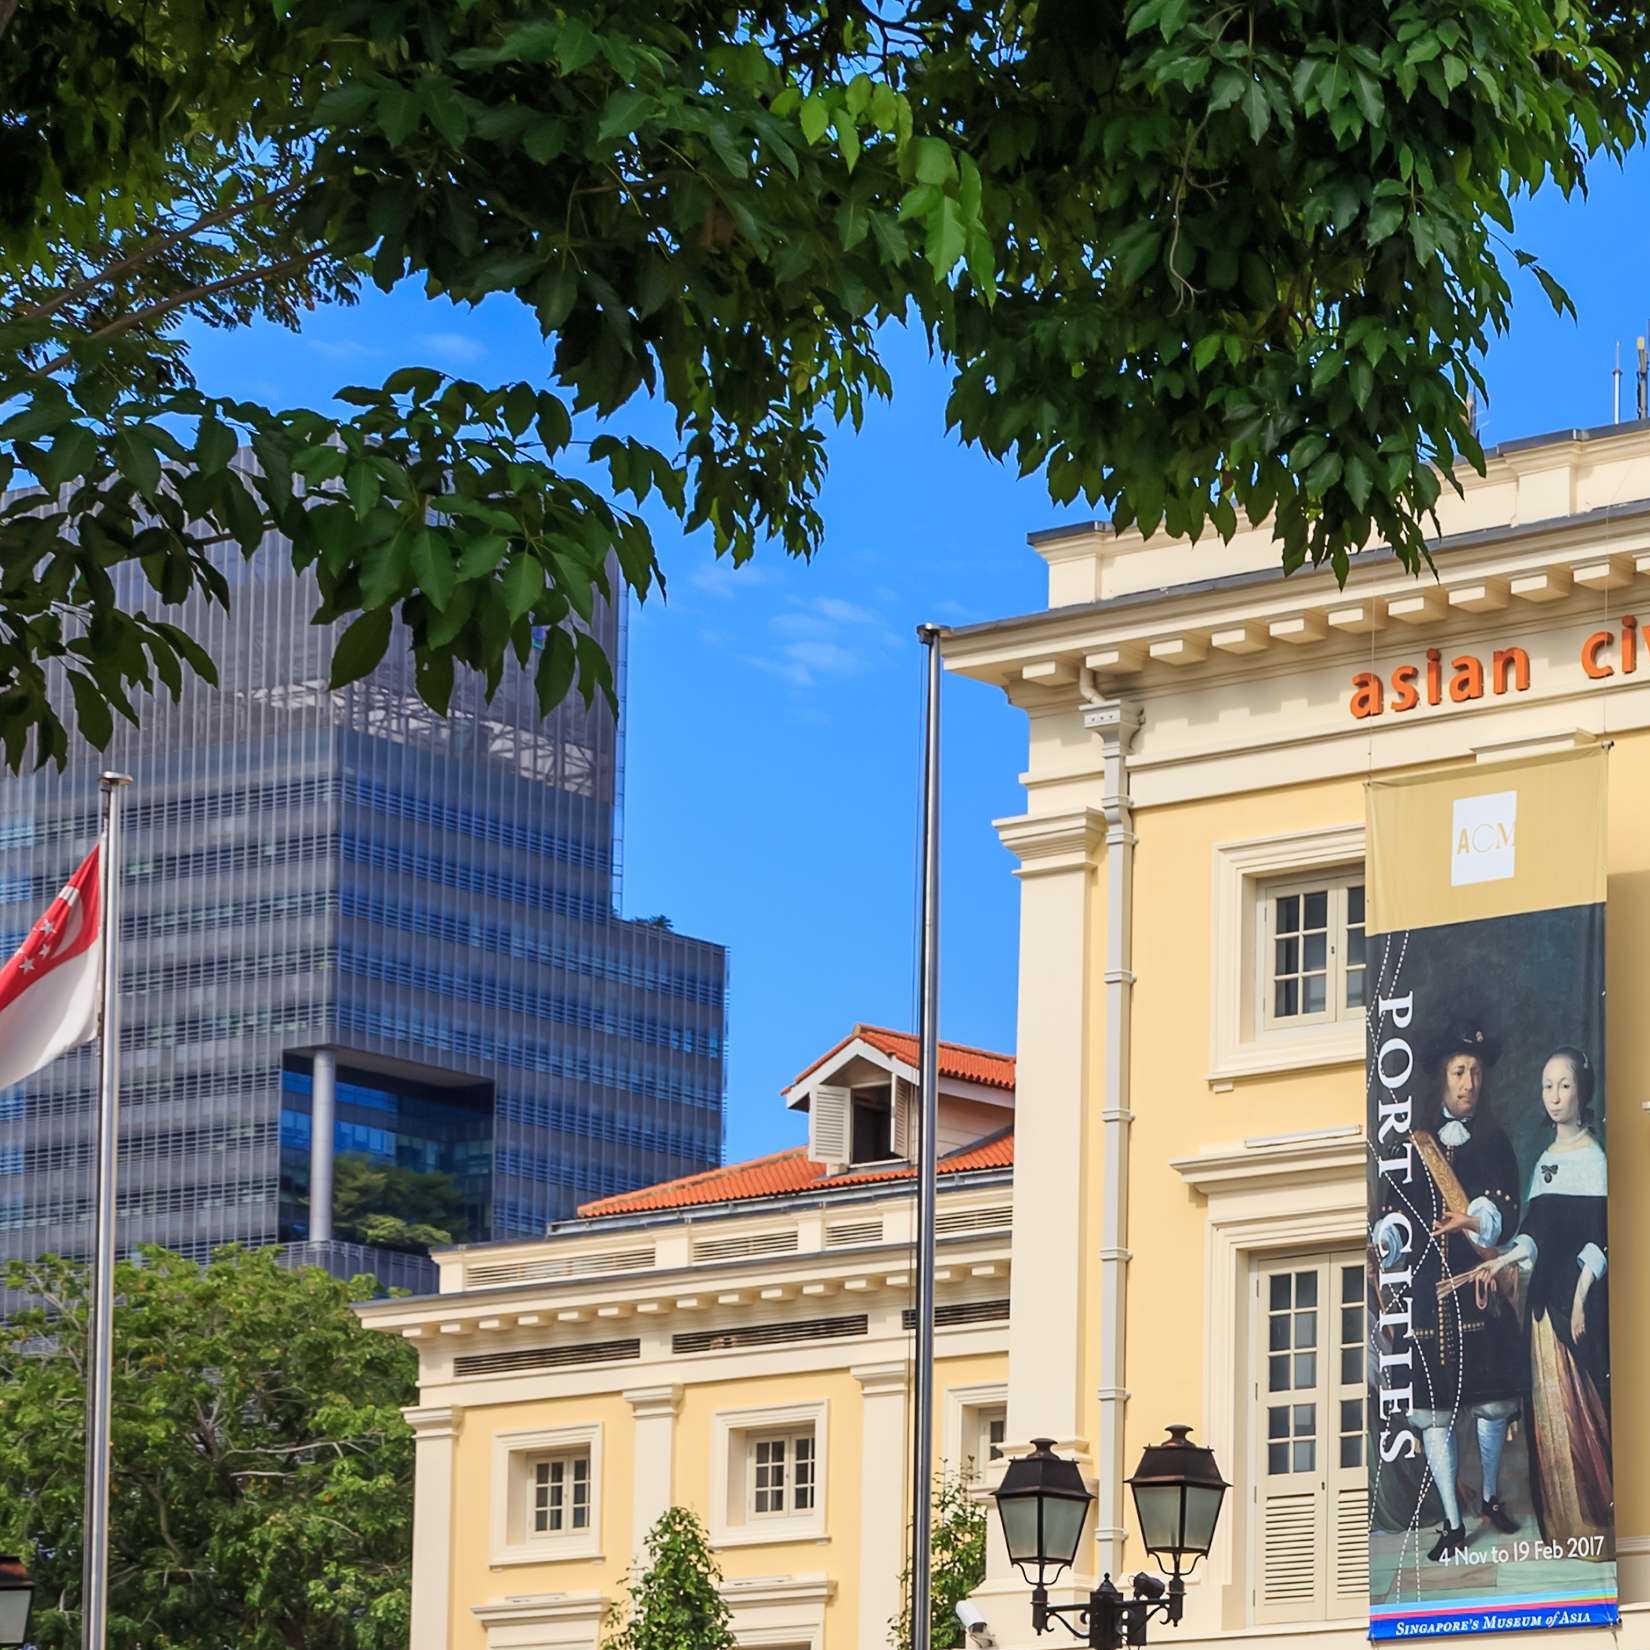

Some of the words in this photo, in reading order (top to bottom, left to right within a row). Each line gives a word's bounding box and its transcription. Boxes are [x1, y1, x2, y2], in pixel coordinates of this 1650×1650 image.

[1349, 646, 1531, 720] asian
[1456, 820, 1517, 856] ACM
[1377, 989, 1414, 1185] PORT
[1378, 1211, 1416, 1464] CITIES
[1438, 1547, 1451, 1568] 4
[1454, 1545, 1489, 1566] Nov
[1491, 1546, 1510, 1564] to
[1513, 1541, 1530, 1562] 19
[1534, 1539, 1563, 1561] Feb
[1566, 1535, 1605, 1558] 2017
[1395, 1617, 1479, 1636] SINGAPORE'S
[1482, 1613, 1542, 1630] MUSEUM
[1545, 1610, 1561, 1628] of
[1560, 1611, 1591, 1625] ASIA
